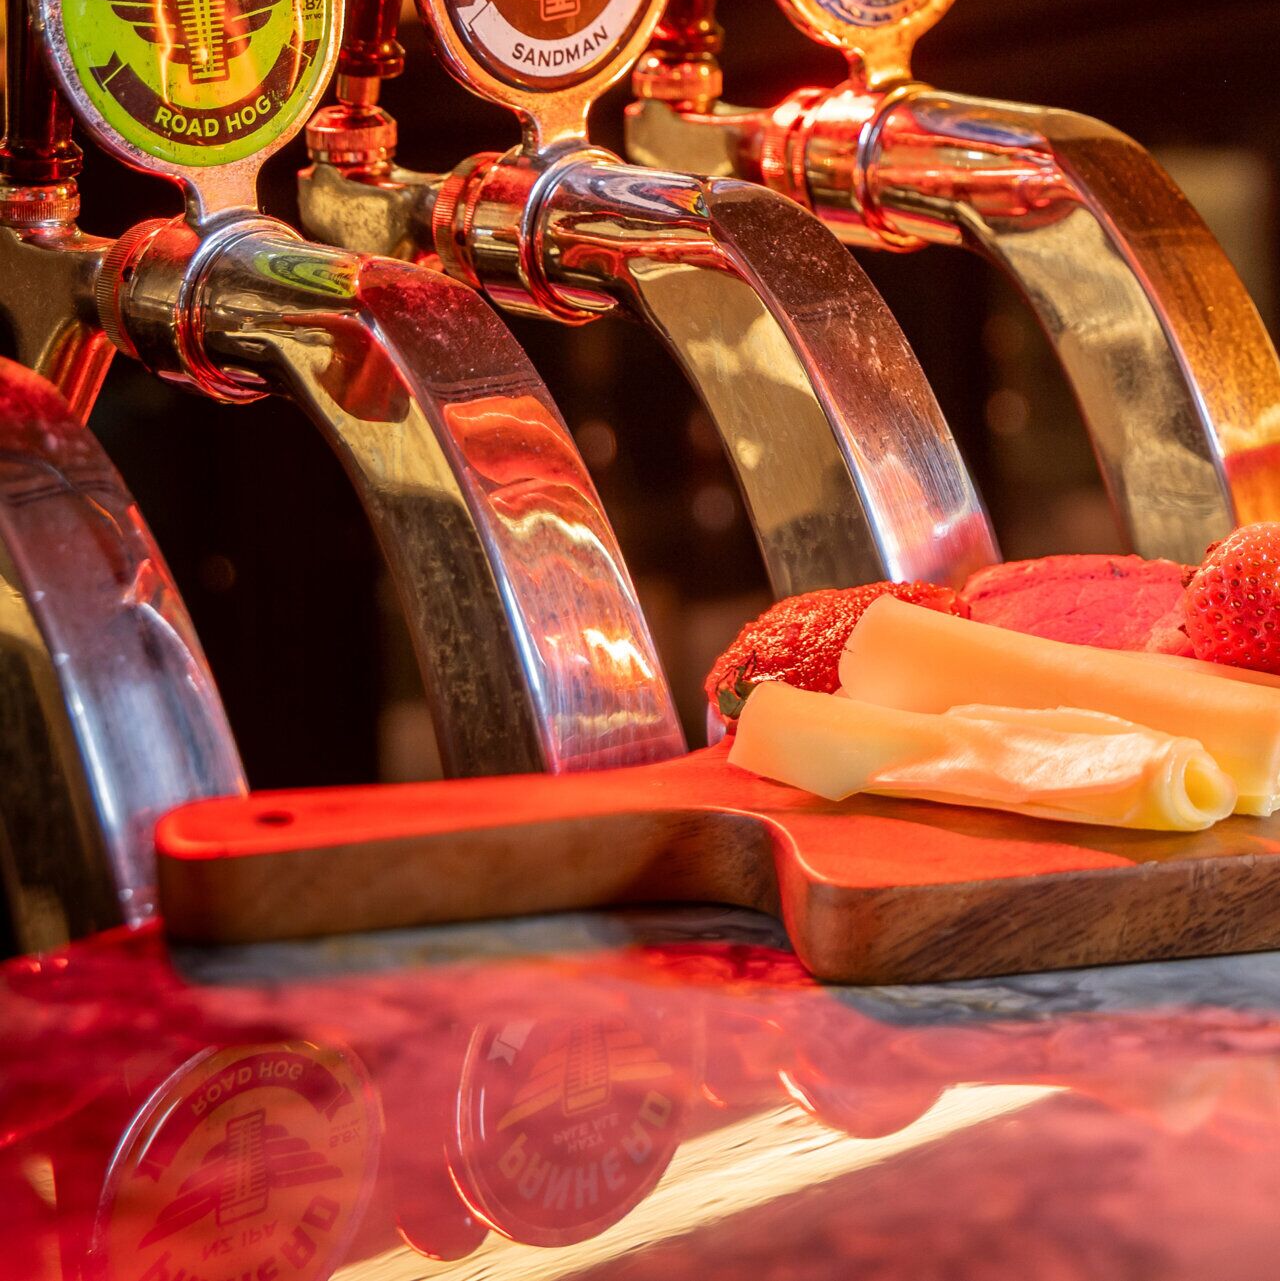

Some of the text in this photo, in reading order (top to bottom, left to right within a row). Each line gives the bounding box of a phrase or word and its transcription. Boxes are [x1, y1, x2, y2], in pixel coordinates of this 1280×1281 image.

[512, 25, 608, 67] SANDMAN
[154, 95, 271, 137] ROAD HOG
